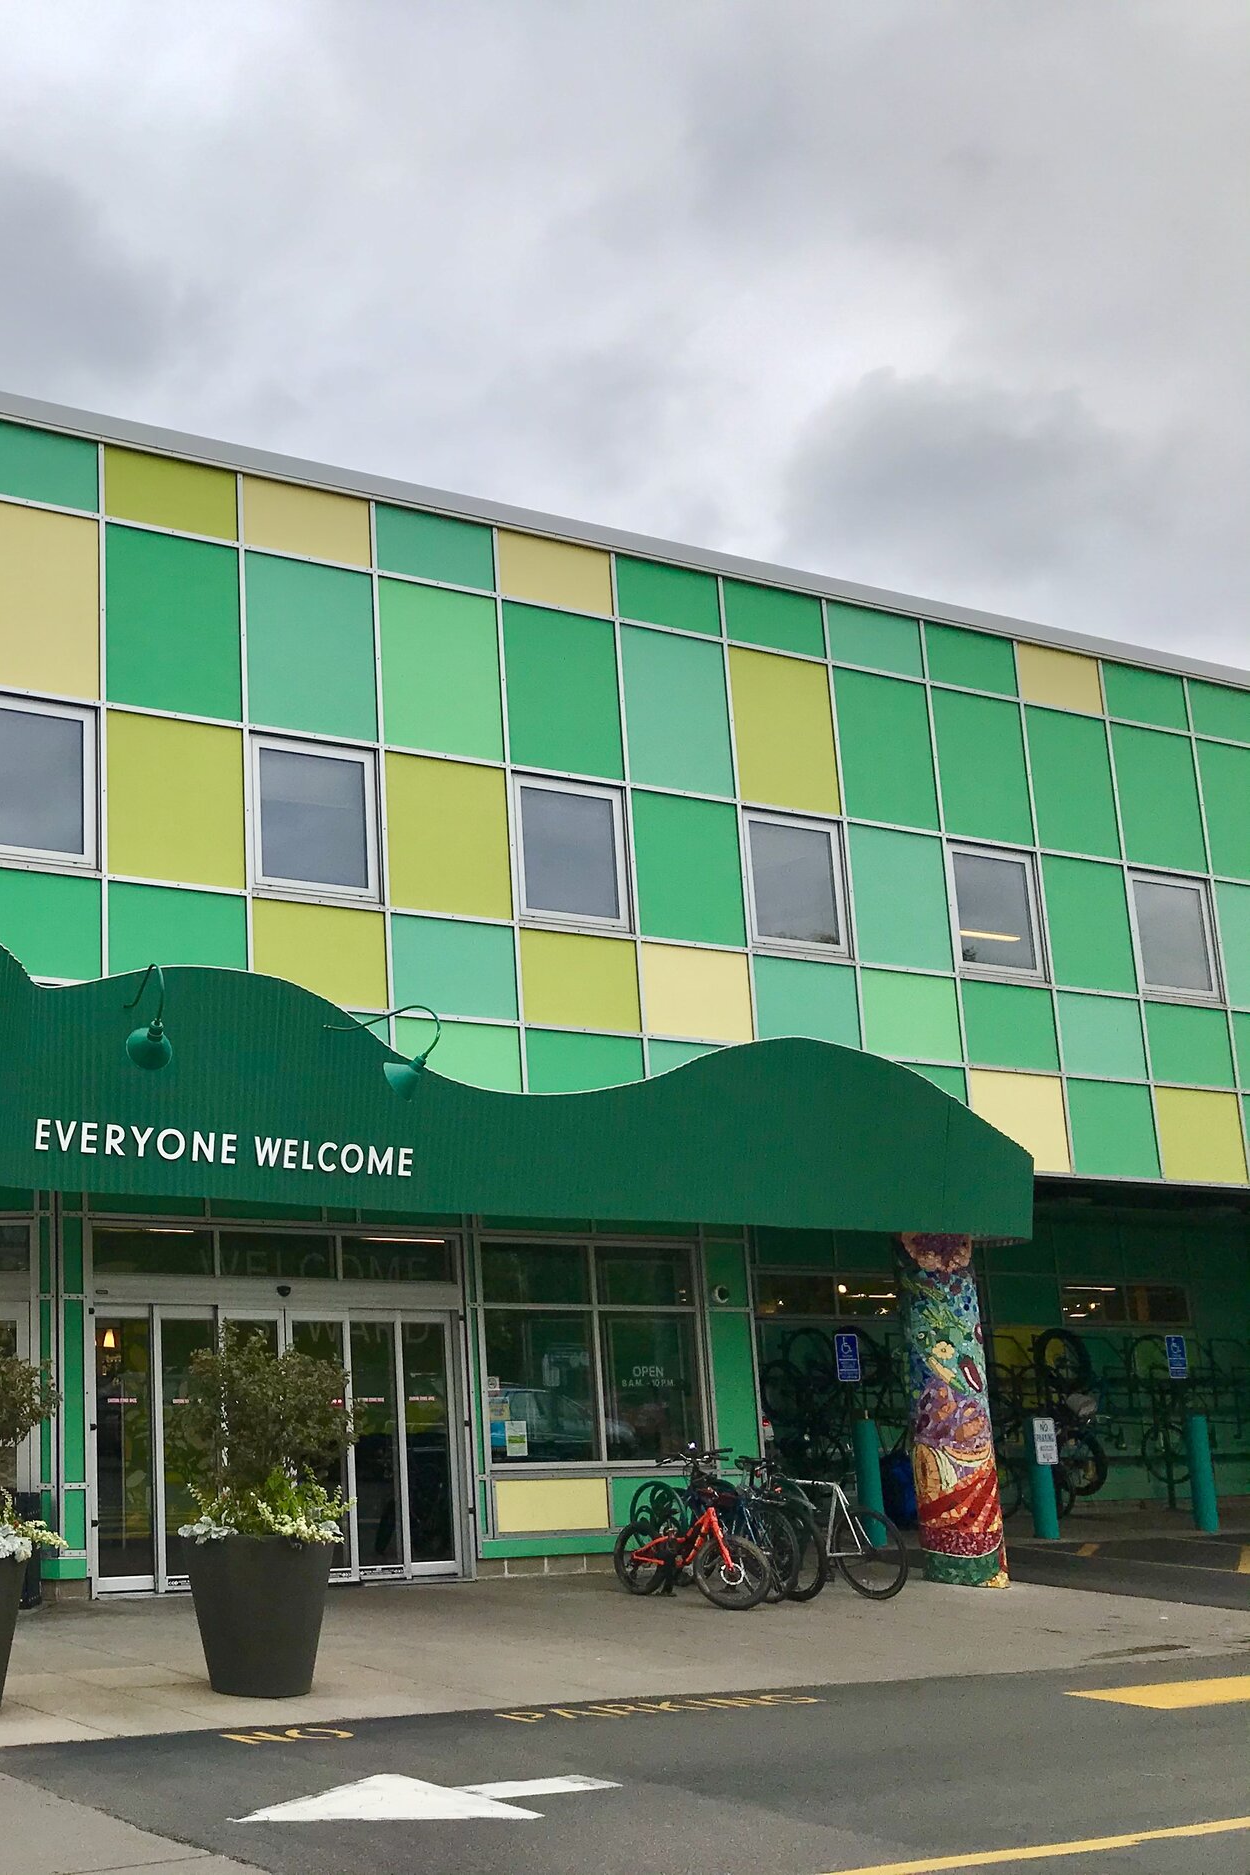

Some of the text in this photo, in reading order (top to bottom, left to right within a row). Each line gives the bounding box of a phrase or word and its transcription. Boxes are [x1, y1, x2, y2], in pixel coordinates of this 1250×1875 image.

[34, 1118, 415, 1177] EVERYONE WELCOME
[621, 1379, 627, 1387] 8
[632, 1365, 664, 1378] OPEN
[219, 1694, 819, 1745] NO PARKING
